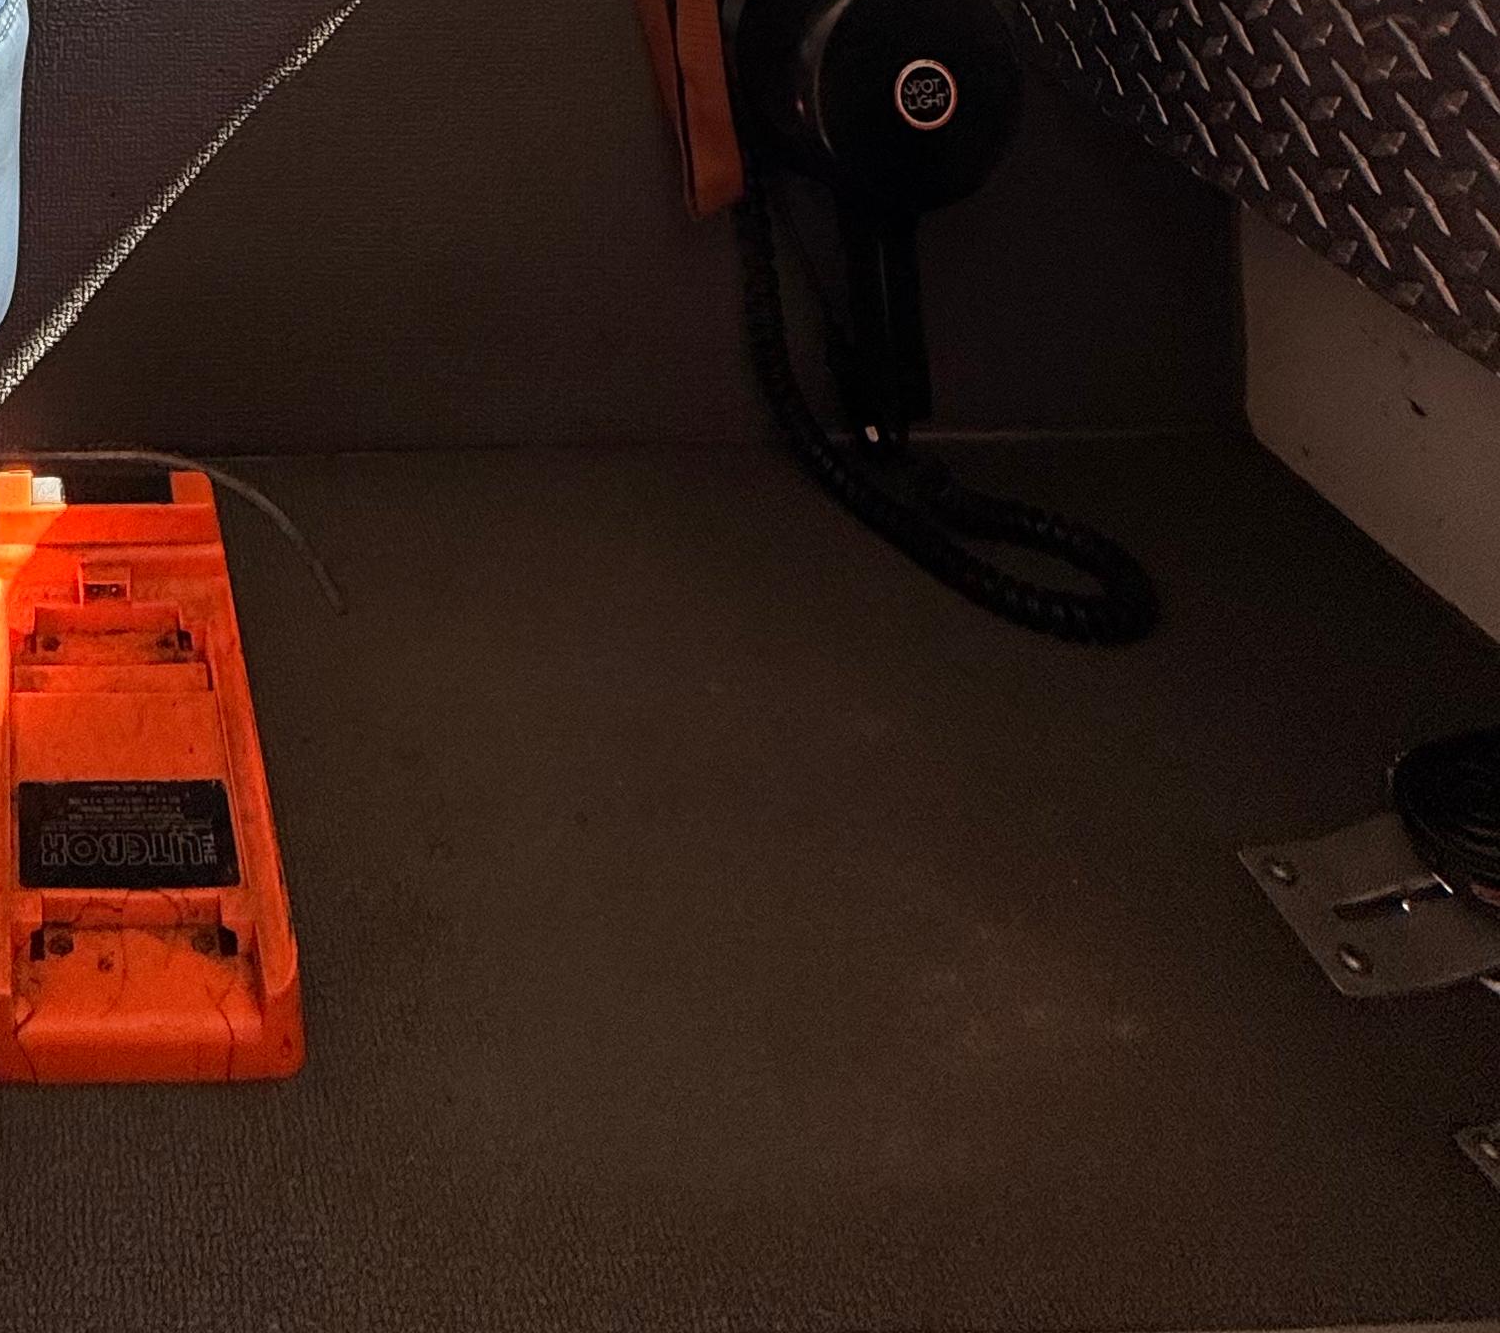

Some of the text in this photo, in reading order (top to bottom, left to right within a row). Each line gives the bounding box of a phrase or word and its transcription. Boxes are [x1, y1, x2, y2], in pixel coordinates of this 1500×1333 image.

[904, 78, 942, 96] SPOT
[906, 93, 947, 111] LIGHT
[40, 831, 216, 867] THE LITEBOX
